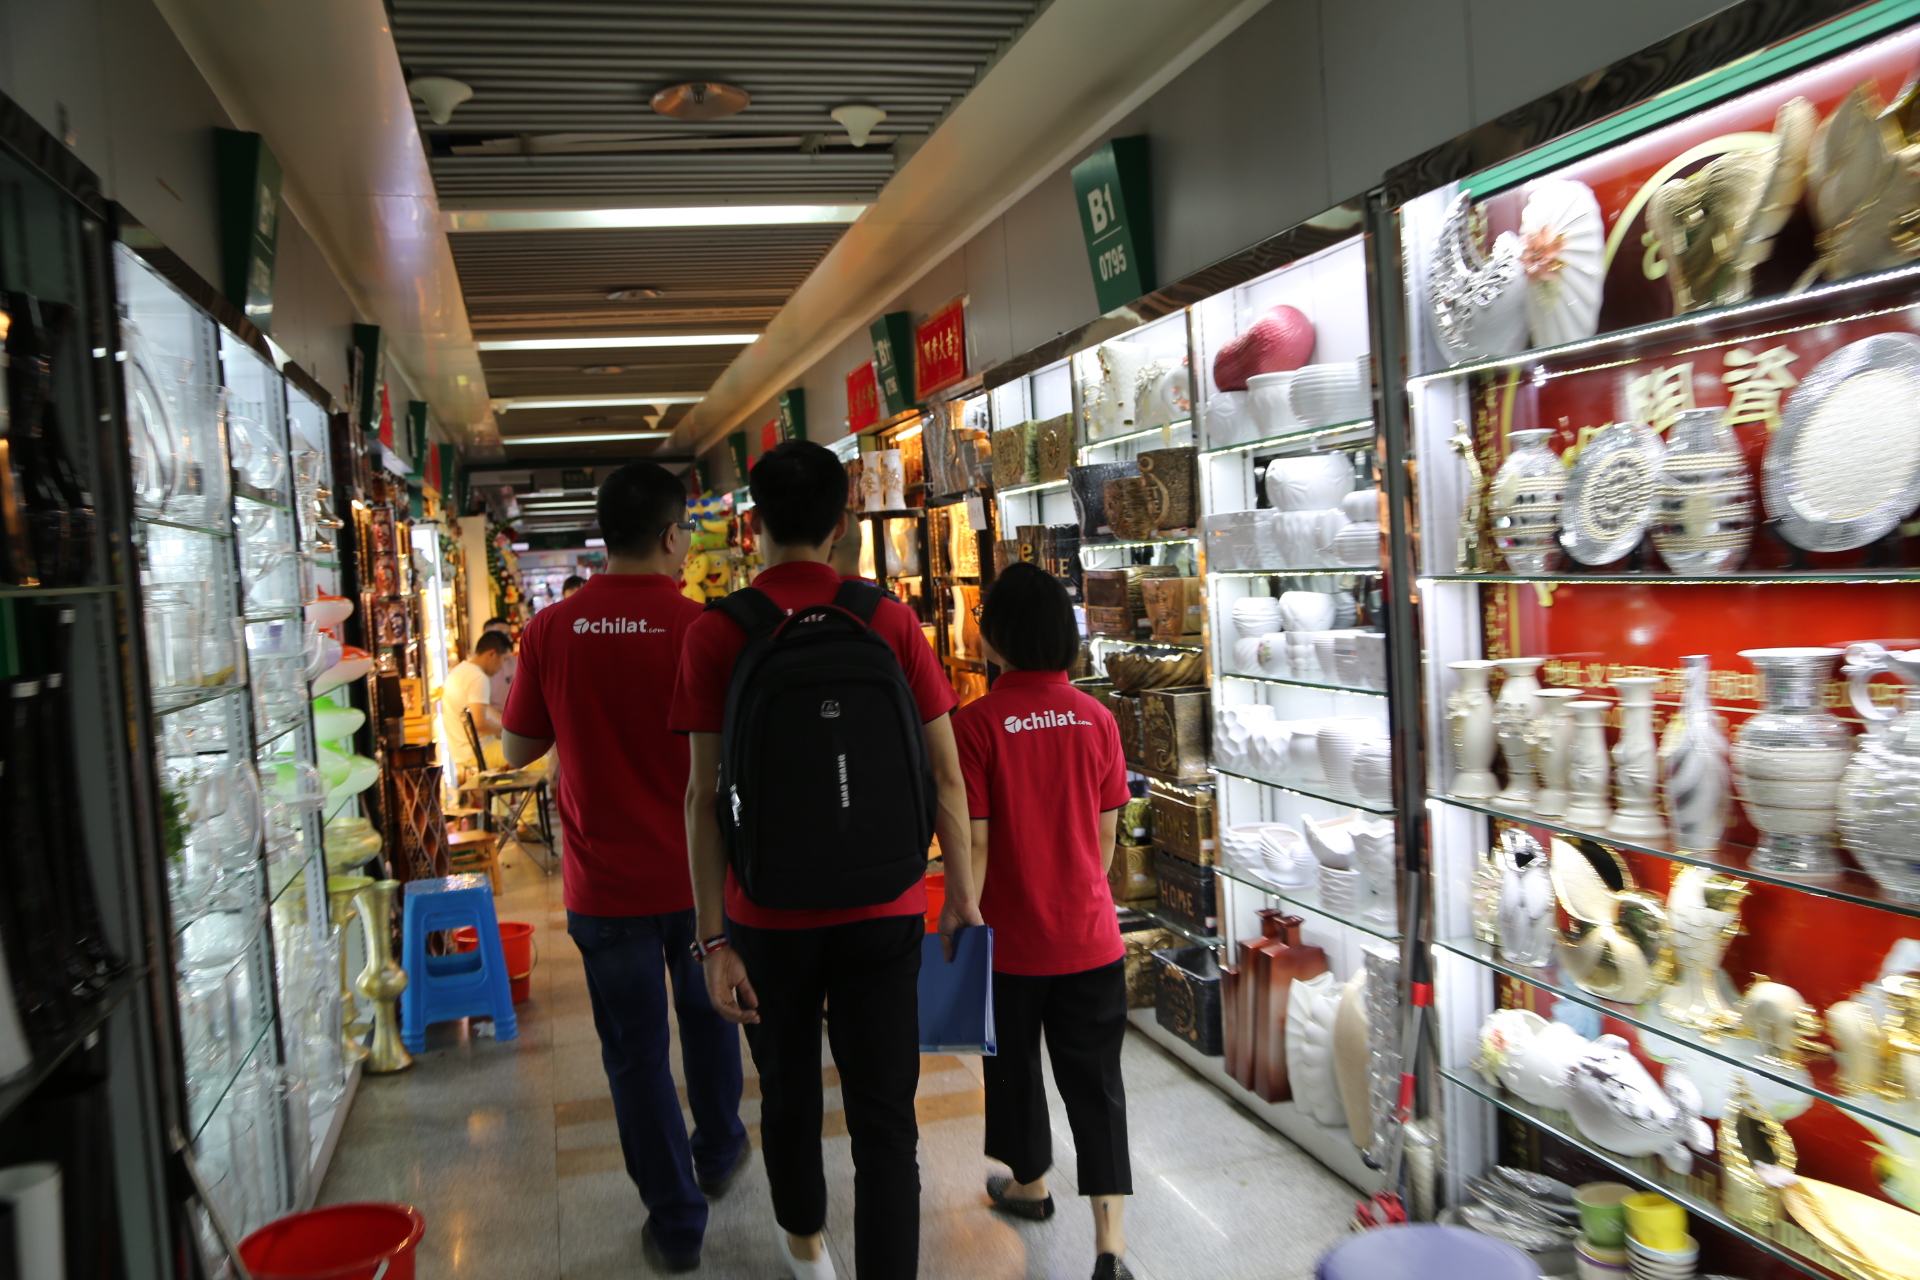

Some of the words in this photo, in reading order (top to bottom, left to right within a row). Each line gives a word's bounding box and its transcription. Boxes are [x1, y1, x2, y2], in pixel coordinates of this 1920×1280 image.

[1087, 183, 1115, 234] B1
[1099, 244, 1127, 281] 0795
[1157, 811, 1190, 845] HOME
[1160, 879, 1195, 917] HOME
